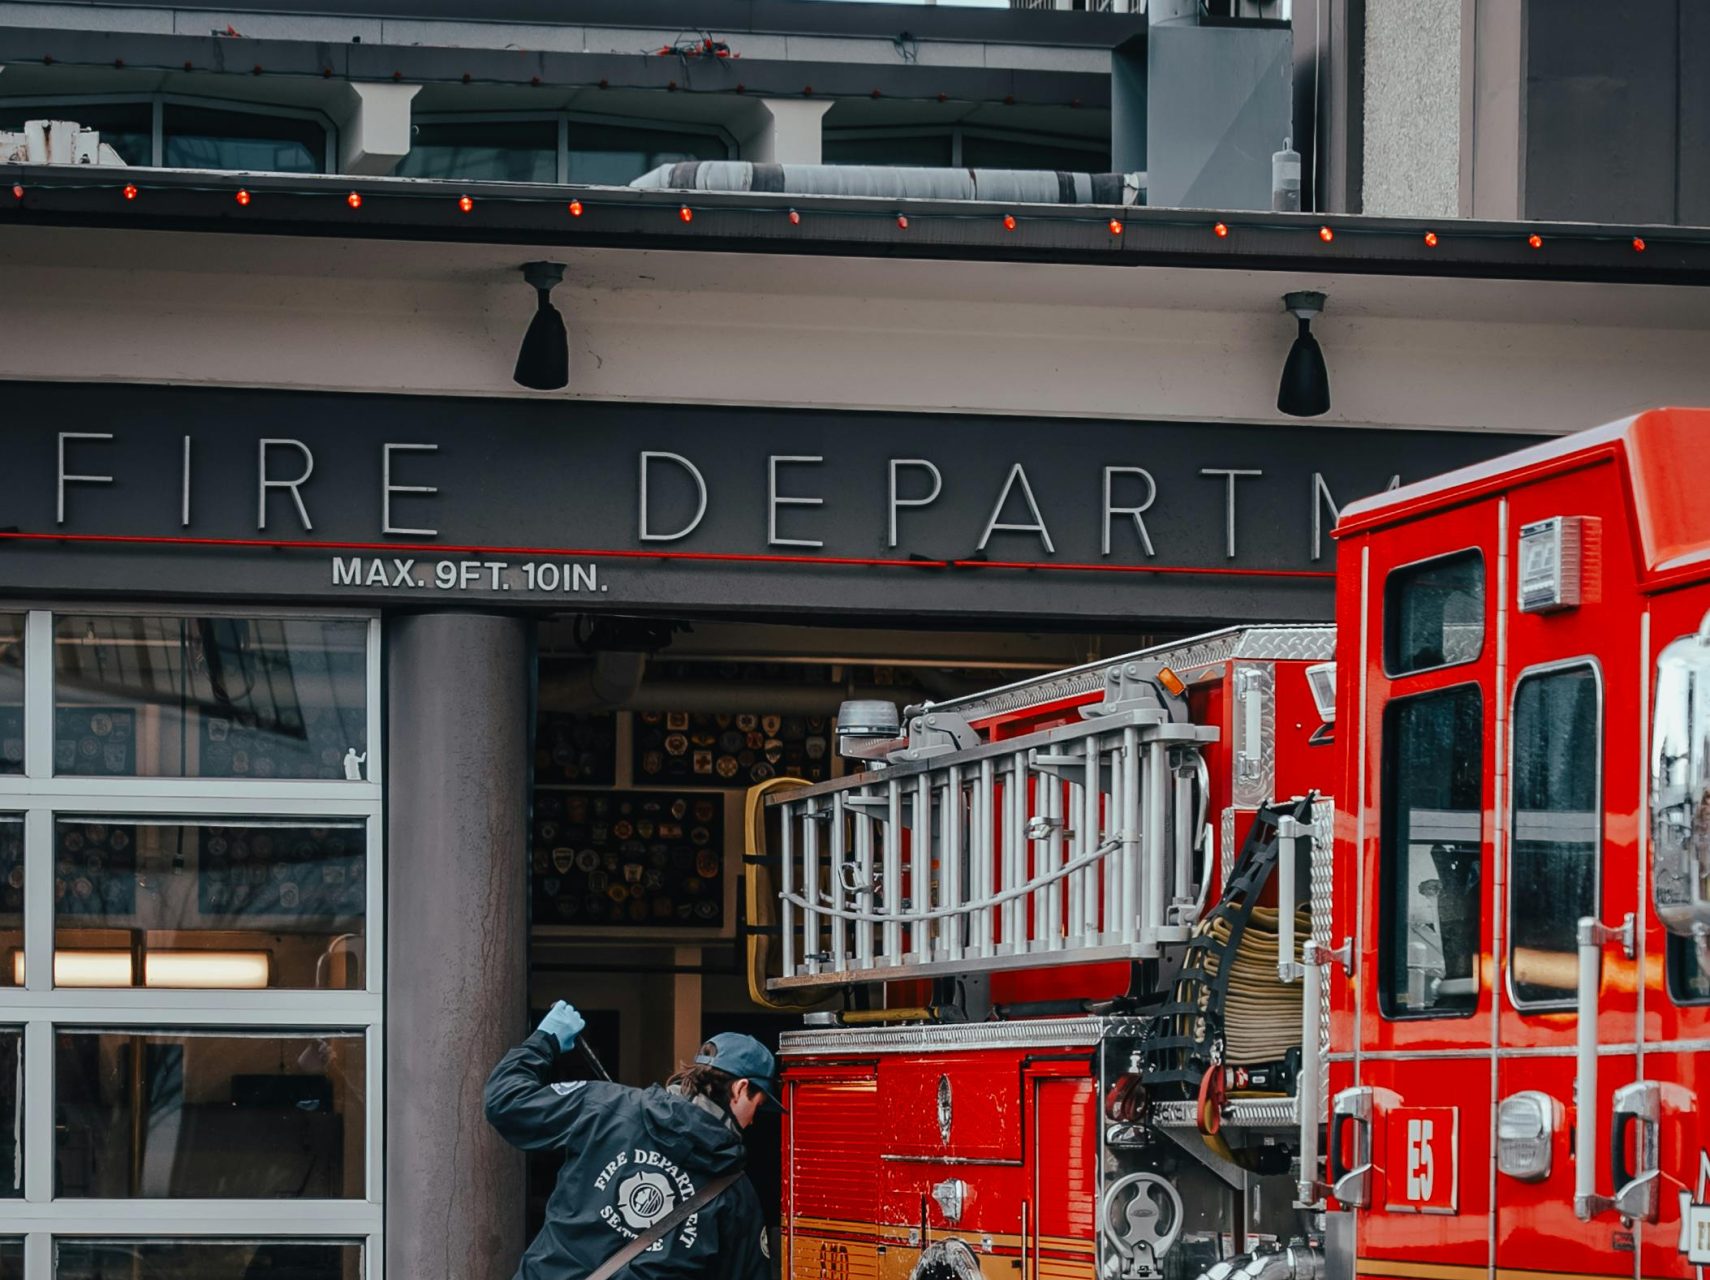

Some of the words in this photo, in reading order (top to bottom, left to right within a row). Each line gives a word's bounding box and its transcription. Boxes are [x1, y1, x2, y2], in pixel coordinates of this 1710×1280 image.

[56, 432, 438, 537] FIRE
[332, 557, 425, 587] MAX.
[435, 560, 509, 590] 9FT.
[522, 562, 608, 592] 10IN.
[594, 1151, 628, 1191] FIRE
[633, 1149, 698, 1249] DEPARTENT
[1407, 1119, 1434, 1202] E5
